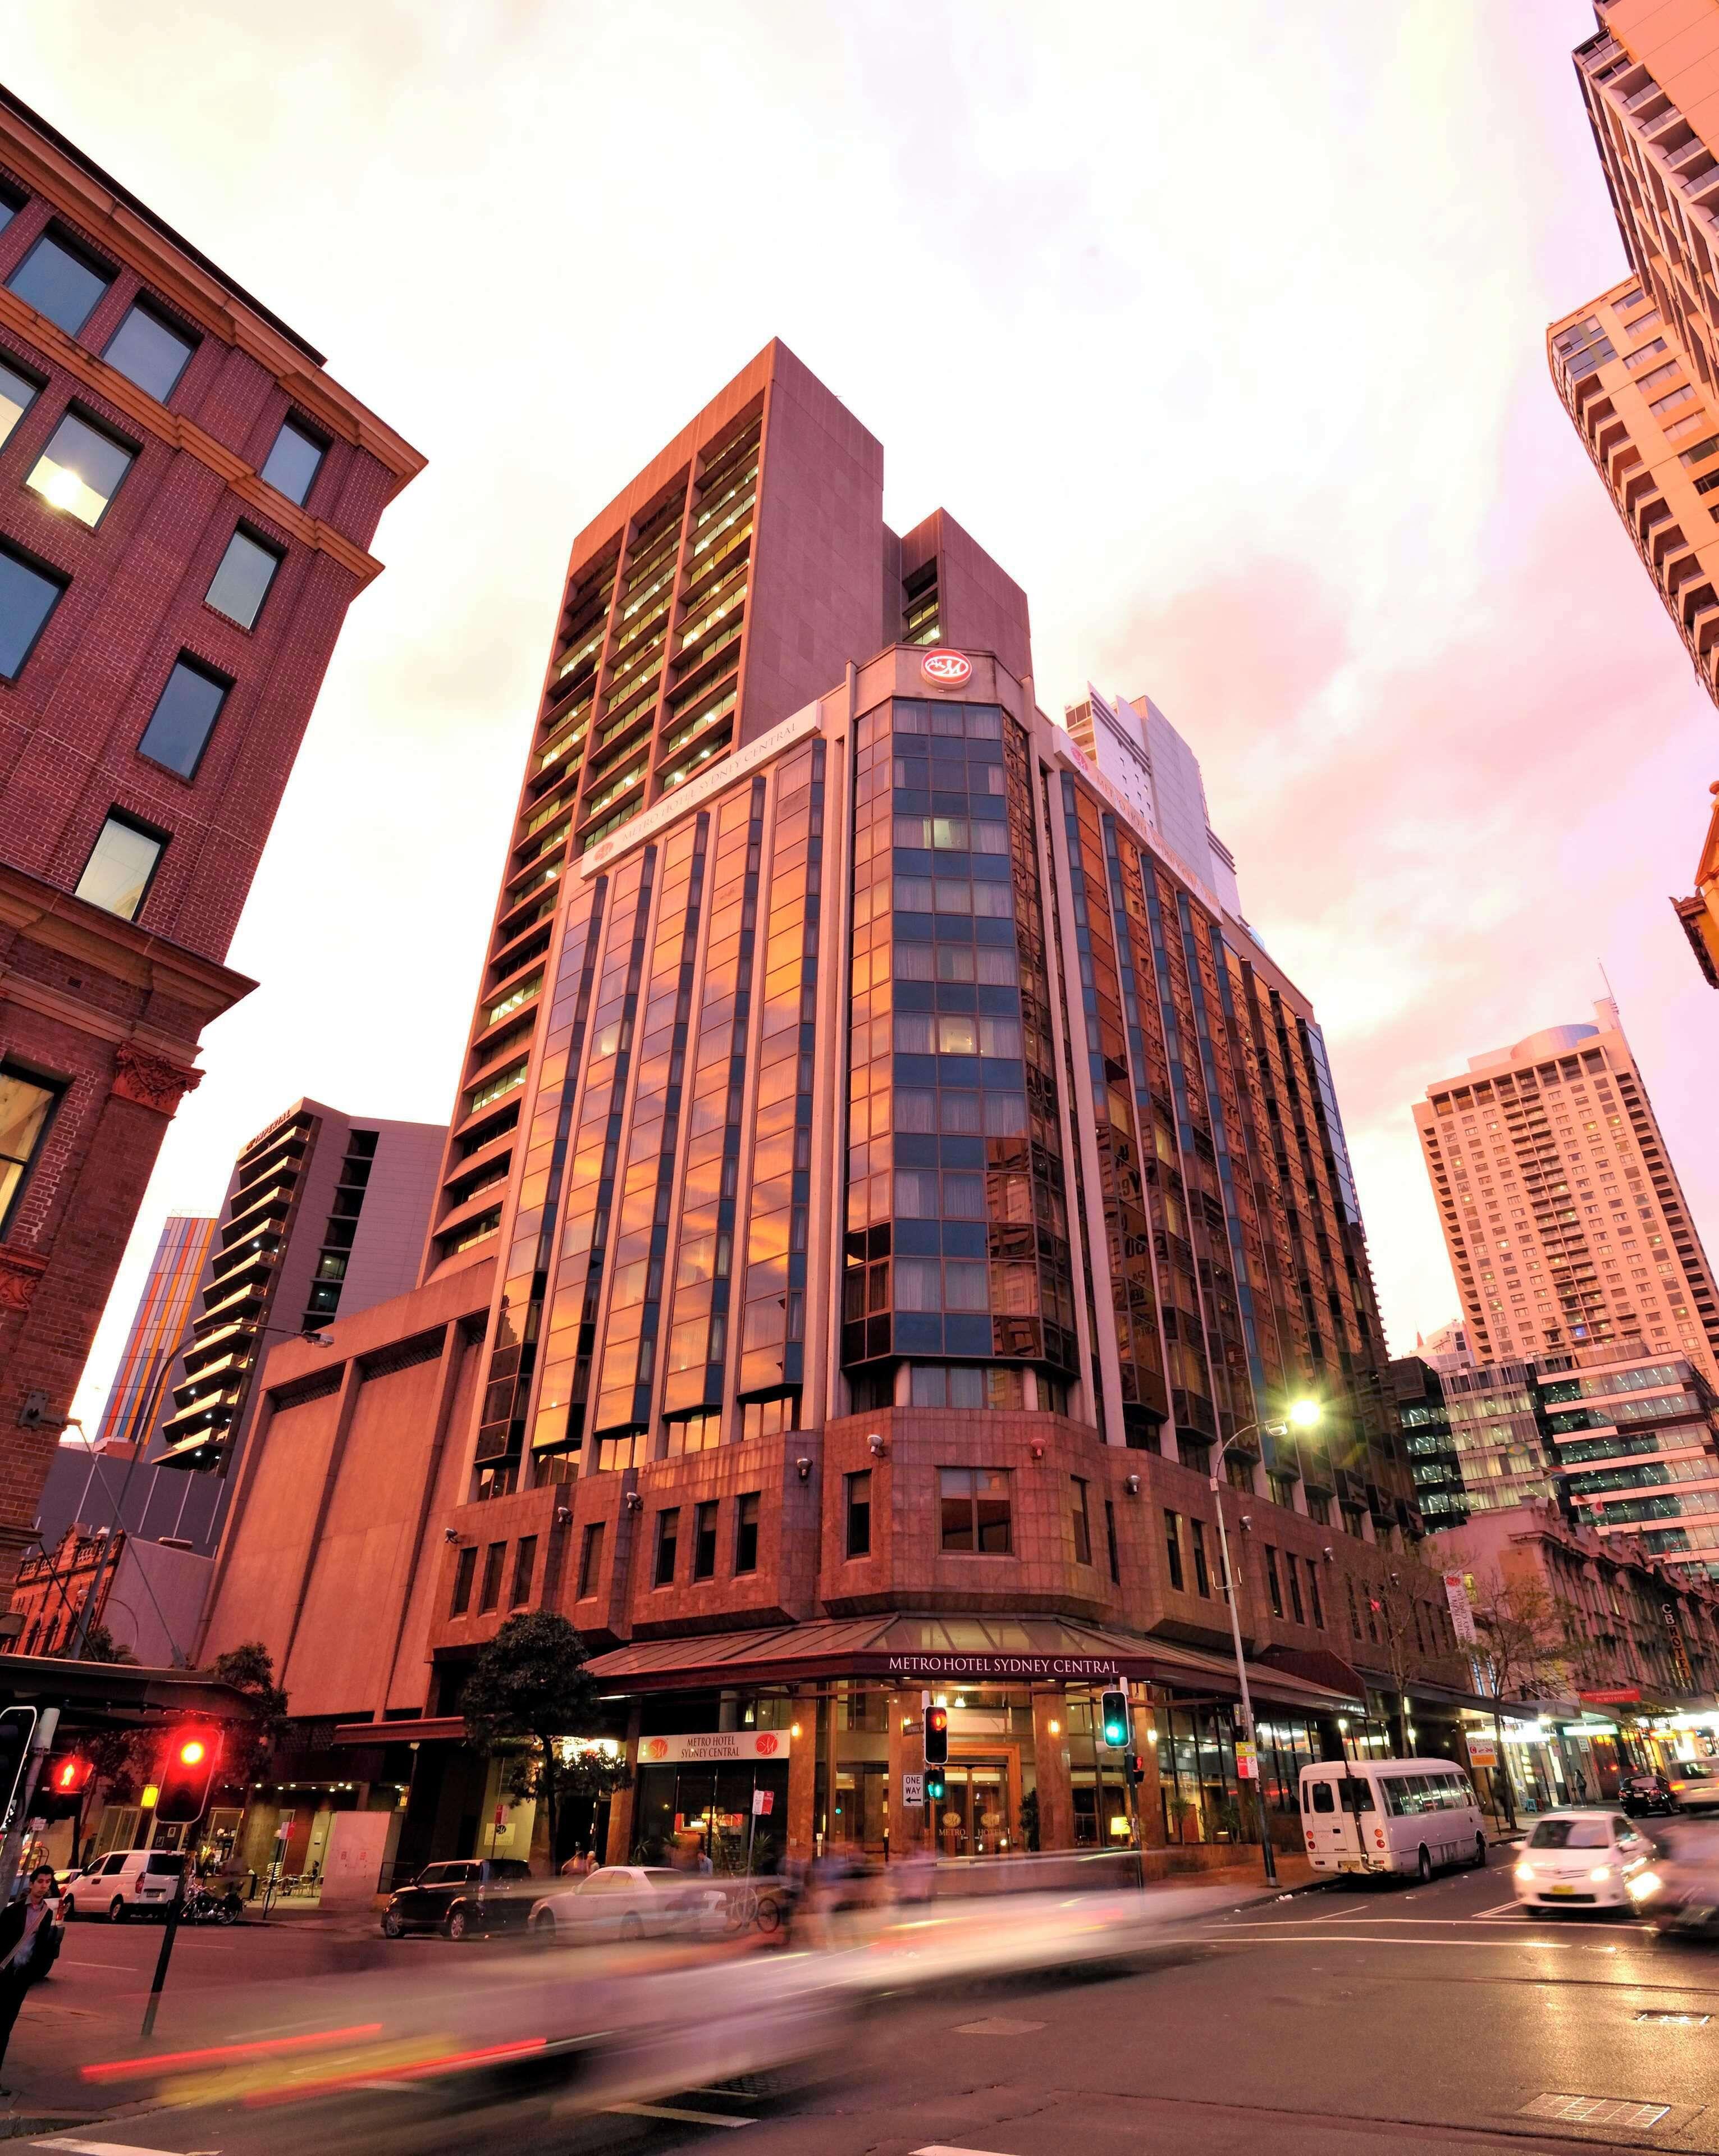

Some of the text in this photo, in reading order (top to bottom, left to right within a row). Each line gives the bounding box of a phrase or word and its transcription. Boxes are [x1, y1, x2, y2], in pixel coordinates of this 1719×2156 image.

[255, 1109, 291, 1144] IMPERIAL
[1661, 1604, 1675, 1625] CB
[889, 1657, 1119, 1674] METRO HOTEL SYDNEY CENTRAL
[687, 1736, 735, 1747] METRO HOTEL
[681, 1747, 740, 1758] SYDNEY CENTRAL
